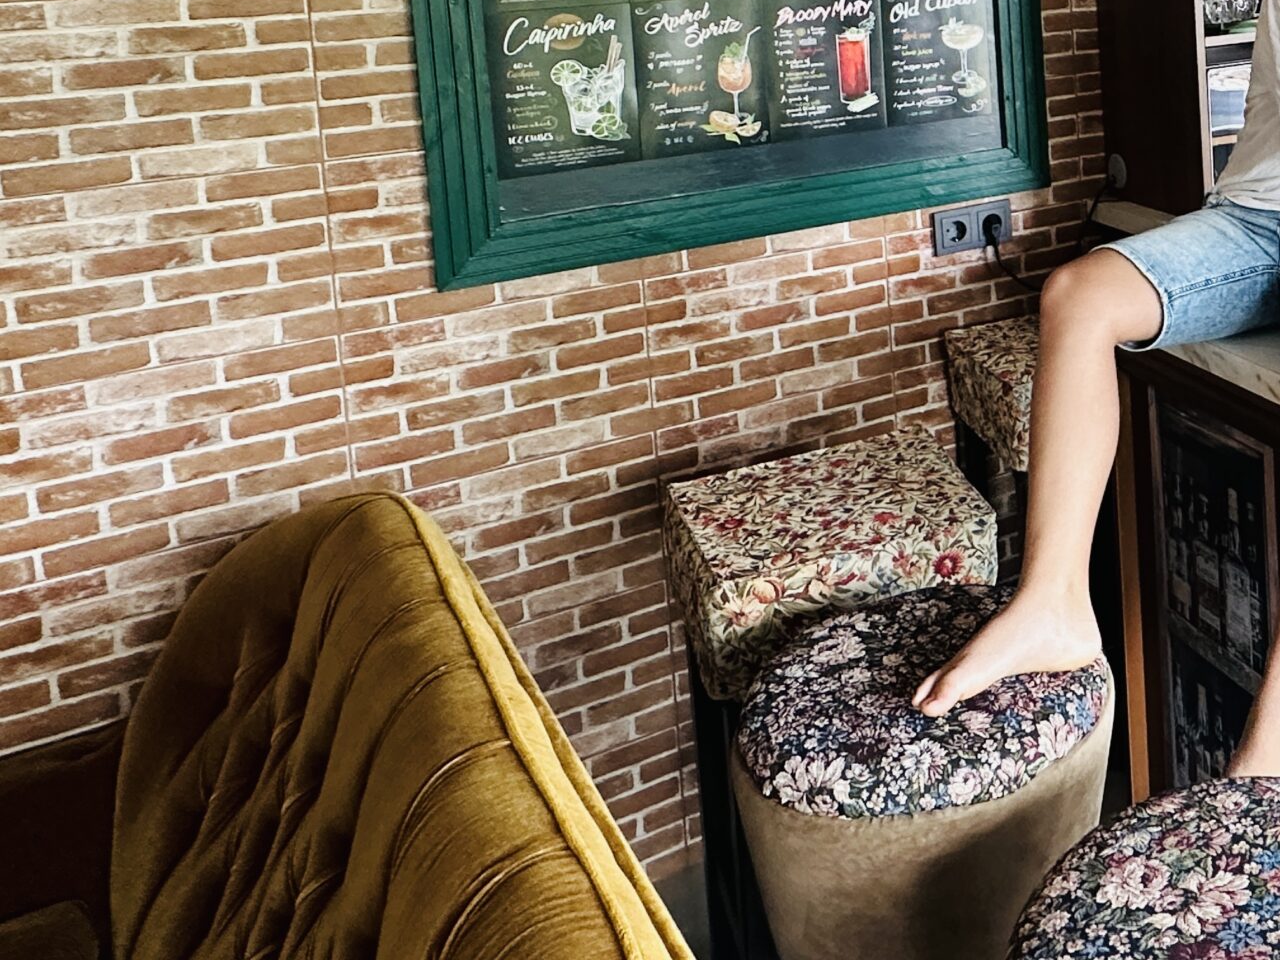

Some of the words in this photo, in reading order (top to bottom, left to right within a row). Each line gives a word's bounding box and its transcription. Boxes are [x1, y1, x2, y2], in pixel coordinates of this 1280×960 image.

[645, 2, 710, 34] Aperol
[685, 16, 743, 48] Spritz
[503, 14, 616, 55] Caipirinha
